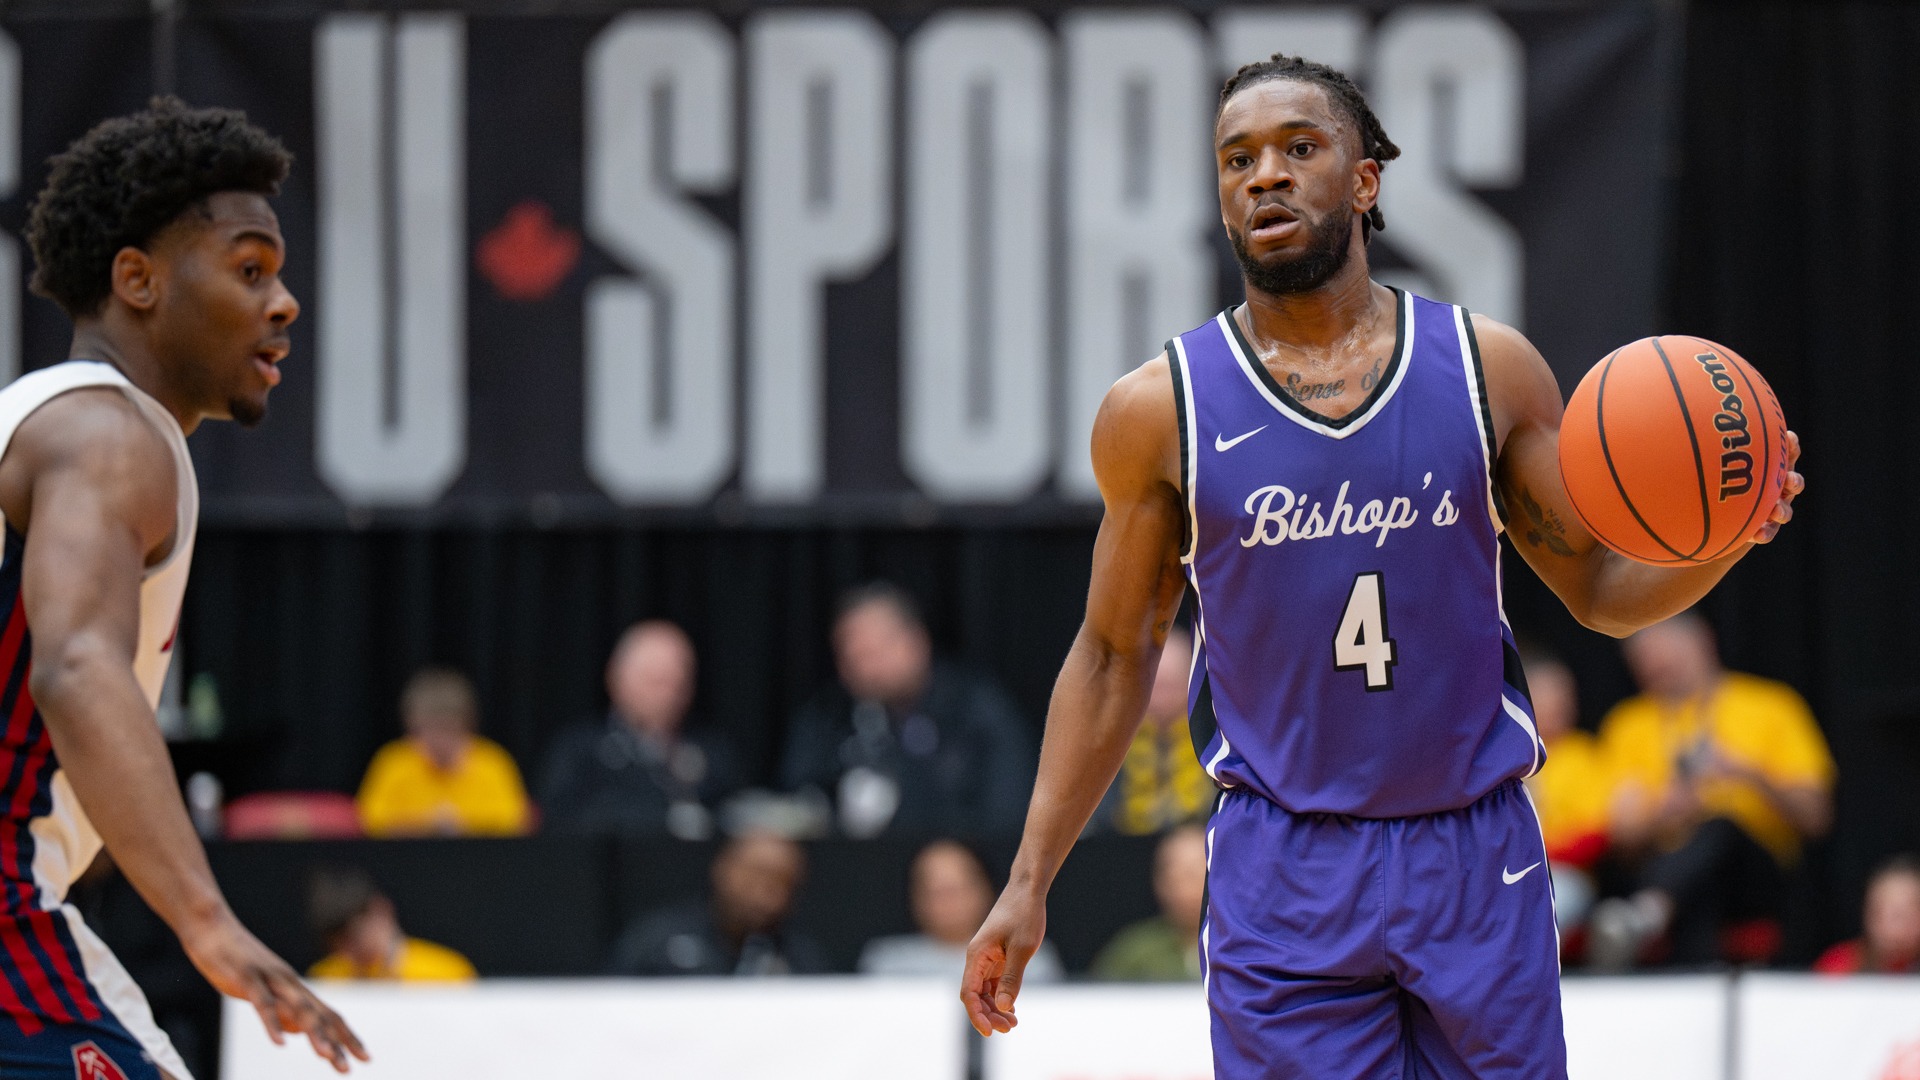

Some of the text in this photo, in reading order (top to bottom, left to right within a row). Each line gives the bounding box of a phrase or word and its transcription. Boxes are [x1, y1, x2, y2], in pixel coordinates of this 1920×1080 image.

[315, 11, 467, 503] U
[1282, 372, 1346, 402] Sense
[1694, 351, 1755, 503] Wilson
[1240, 471, 1459, 548] Bishop's
[1331, 570, 1398, 692] 4
